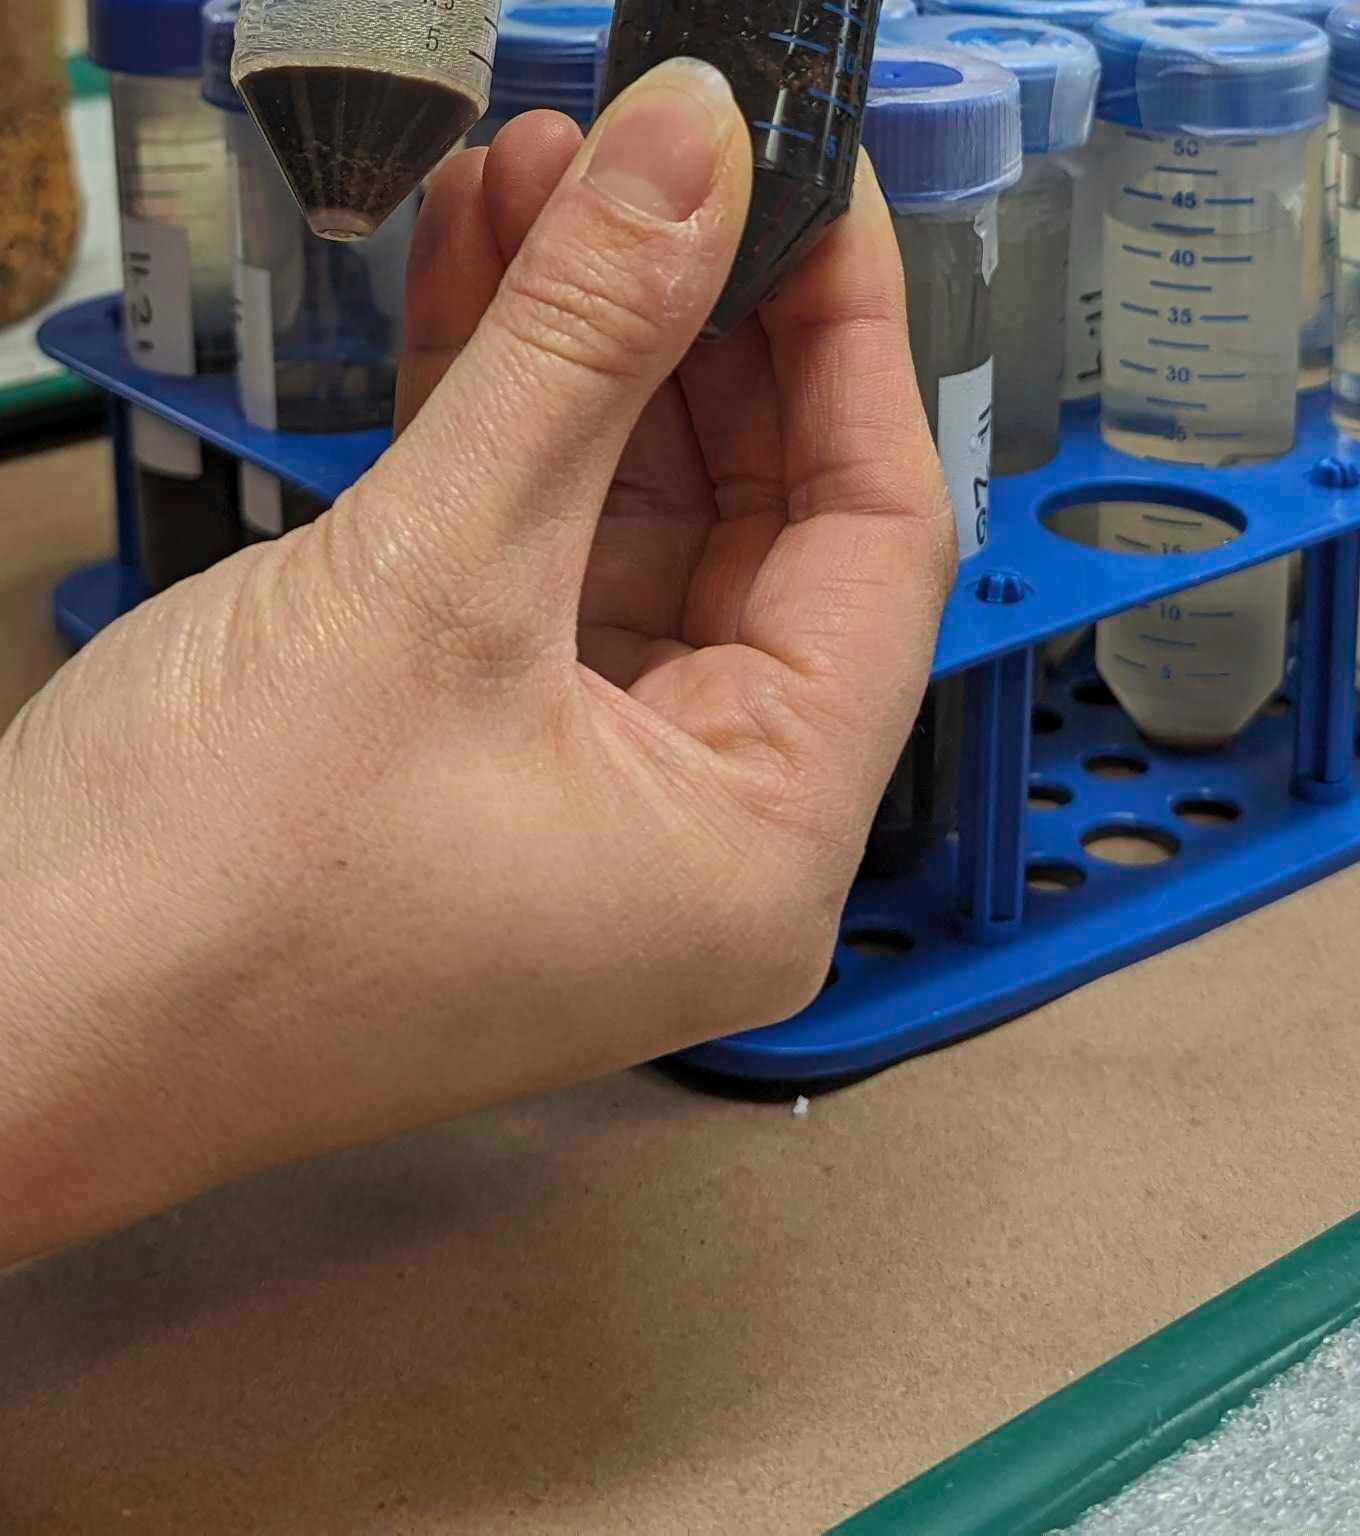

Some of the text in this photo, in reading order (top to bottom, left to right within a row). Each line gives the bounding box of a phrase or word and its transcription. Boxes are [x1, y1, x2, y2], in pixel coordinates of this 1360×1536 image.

[426, 26, 440, 52] 5
[1171, 191, 1197, 209] 45
[1169, 248, 1195, 267] 40
[1167, 306, 1193, 325] 35
[1165, 365, 1191, 383] 30
